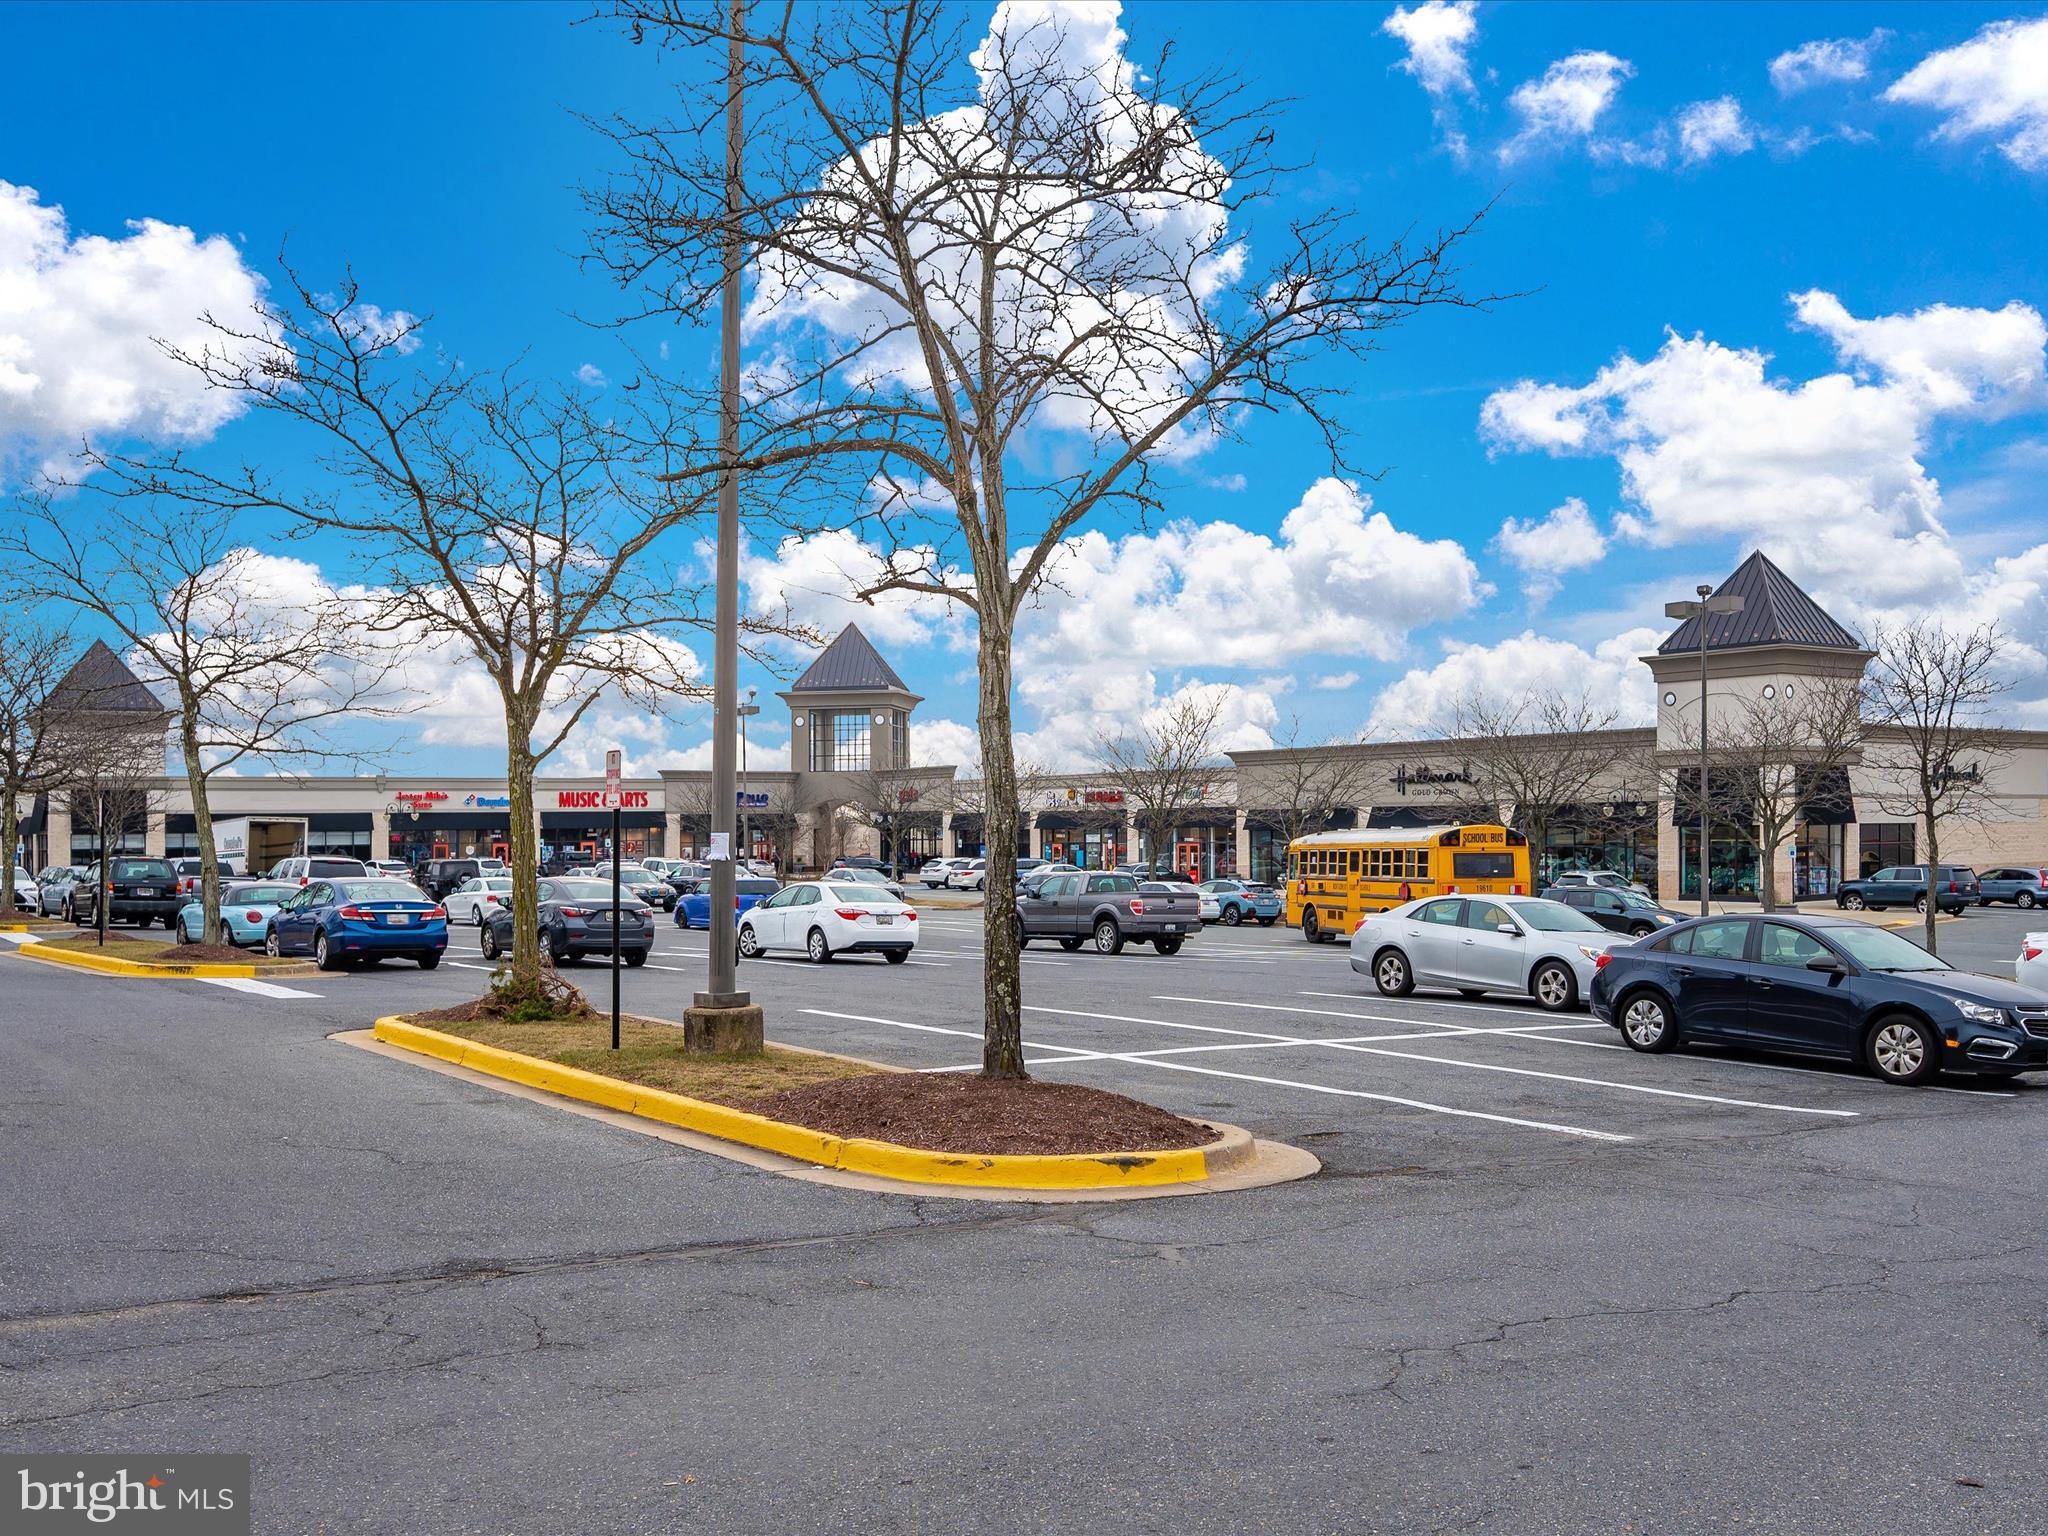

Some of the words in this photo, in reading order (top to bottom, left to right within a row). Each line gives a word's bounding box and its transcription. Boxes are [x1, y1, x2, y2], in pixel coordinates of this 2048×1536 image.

[1389, 763, 1481, 796] Hallmark
[558, 791, 600, 808] MUSIC
[1462, 833, 1488, 843] SCHOOL
[1490, 832, 1504, 843] BUS
